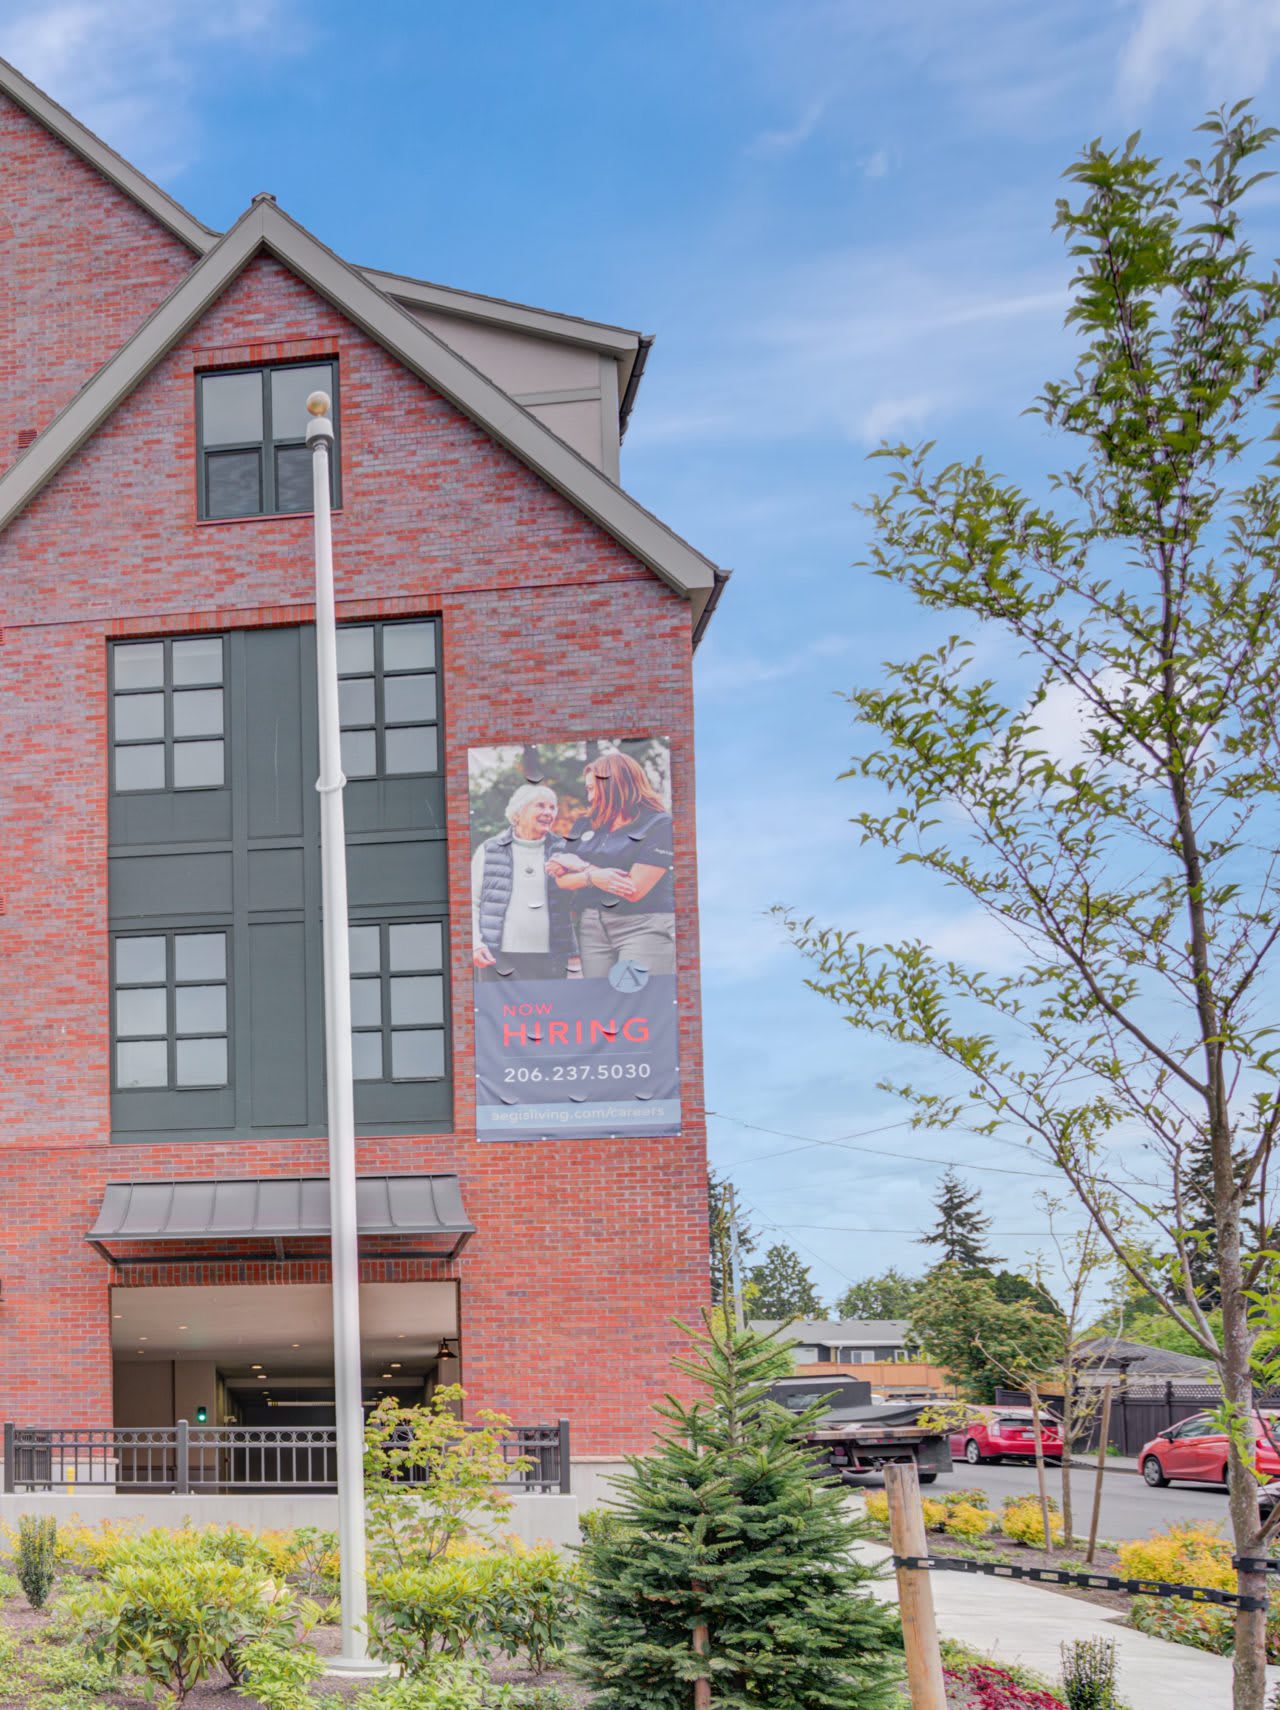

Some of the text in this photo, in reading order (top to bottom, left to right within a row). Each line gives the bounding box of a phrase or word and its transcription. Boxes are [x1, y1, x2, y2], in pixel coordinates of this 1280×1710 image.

[502, 1003, 553, 1017] NOW
[502, 1017, 650, 1047] HIRING
[503, 1063, 651, 1083] 206.237.5030
[491, 1106, 665, 1124] aegisliving.com/careers
